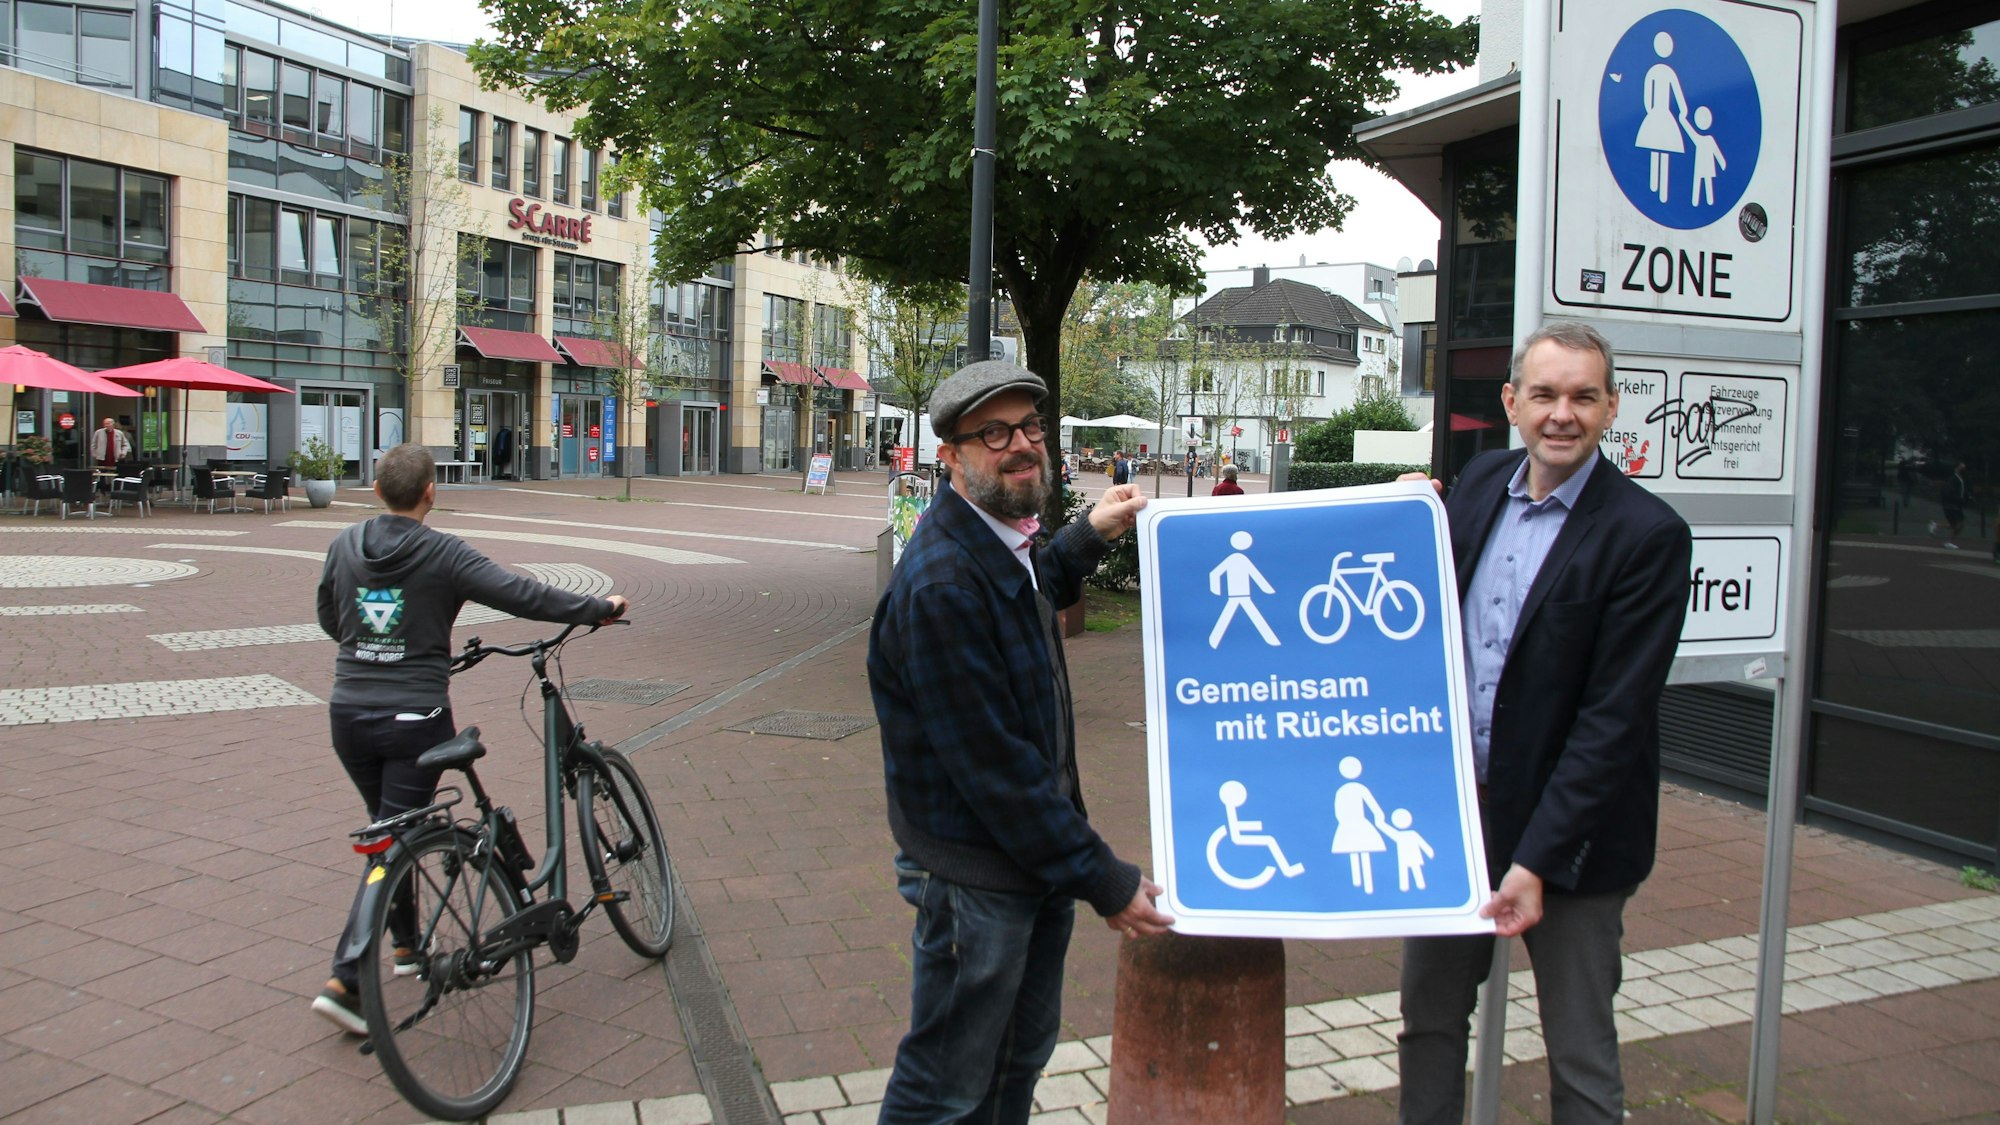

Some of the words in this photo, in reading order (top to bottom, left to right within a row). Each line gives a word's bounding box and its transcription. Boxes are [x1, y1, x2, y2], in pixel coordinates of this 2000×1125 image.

[1622, 243, 1733, 299] ZONE
[1711, 385, 1759, 401] Fahrzeuge
[1704, 438, 1760, 454] Amtsgericht
[1723, 457, 1739, 469] frei
[1691, 566, 1752, 612] frei
[1175, 674, 1369, 705] Gemeinsam
[1215, 713, 1268, 741] mit
[1276, 706, 1444, 739] Rücksicht
